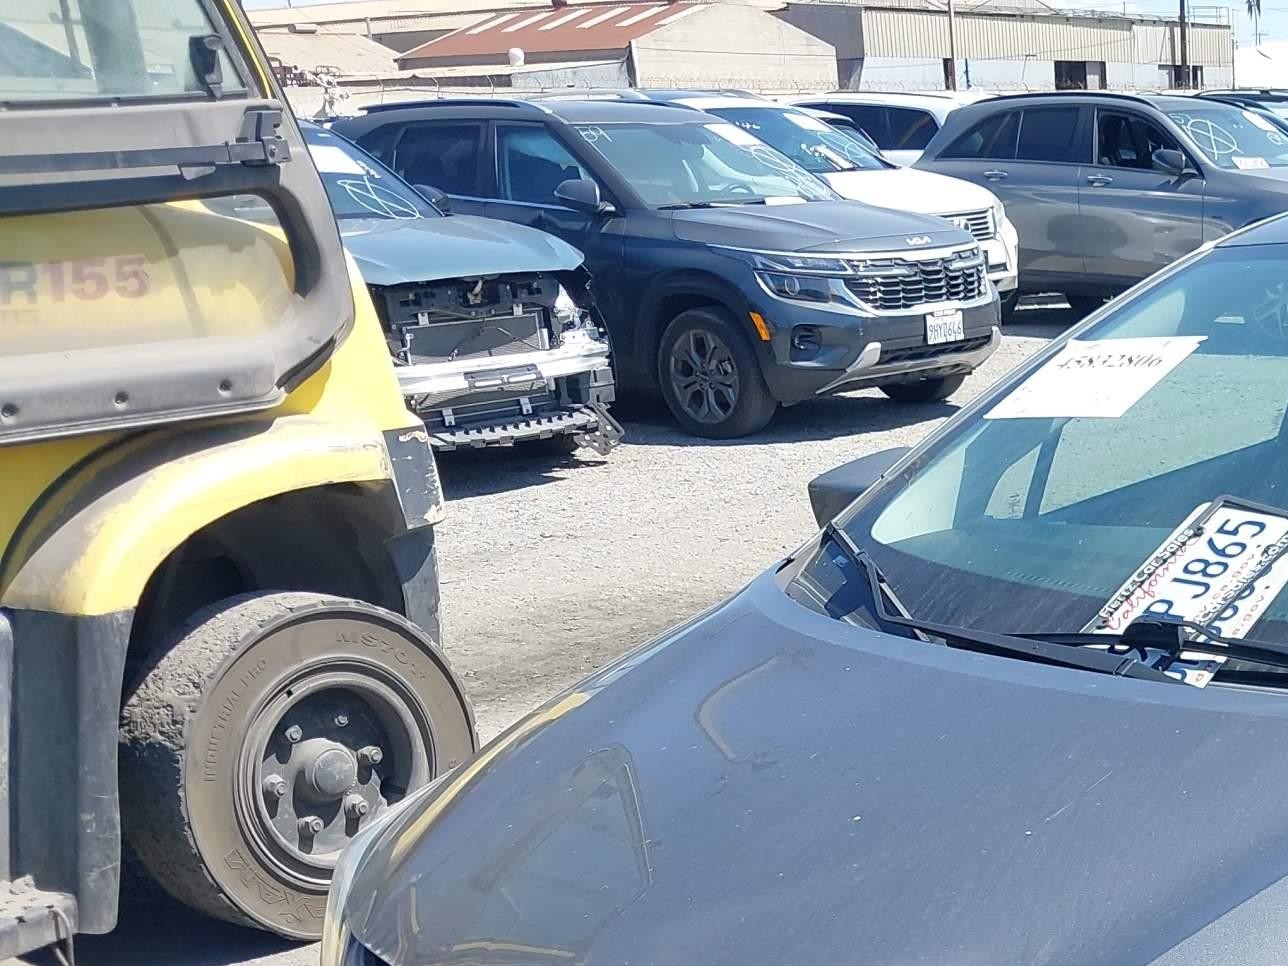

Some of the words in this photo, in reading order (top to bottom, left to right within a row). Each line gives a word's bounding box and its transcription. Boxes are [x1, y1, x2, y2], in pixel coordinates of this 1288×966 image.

[1099, 577, 1139, 619] Hertz
[1134, 556, 1165, 585] Car
[1159, 528, 1195, 562] Sales
